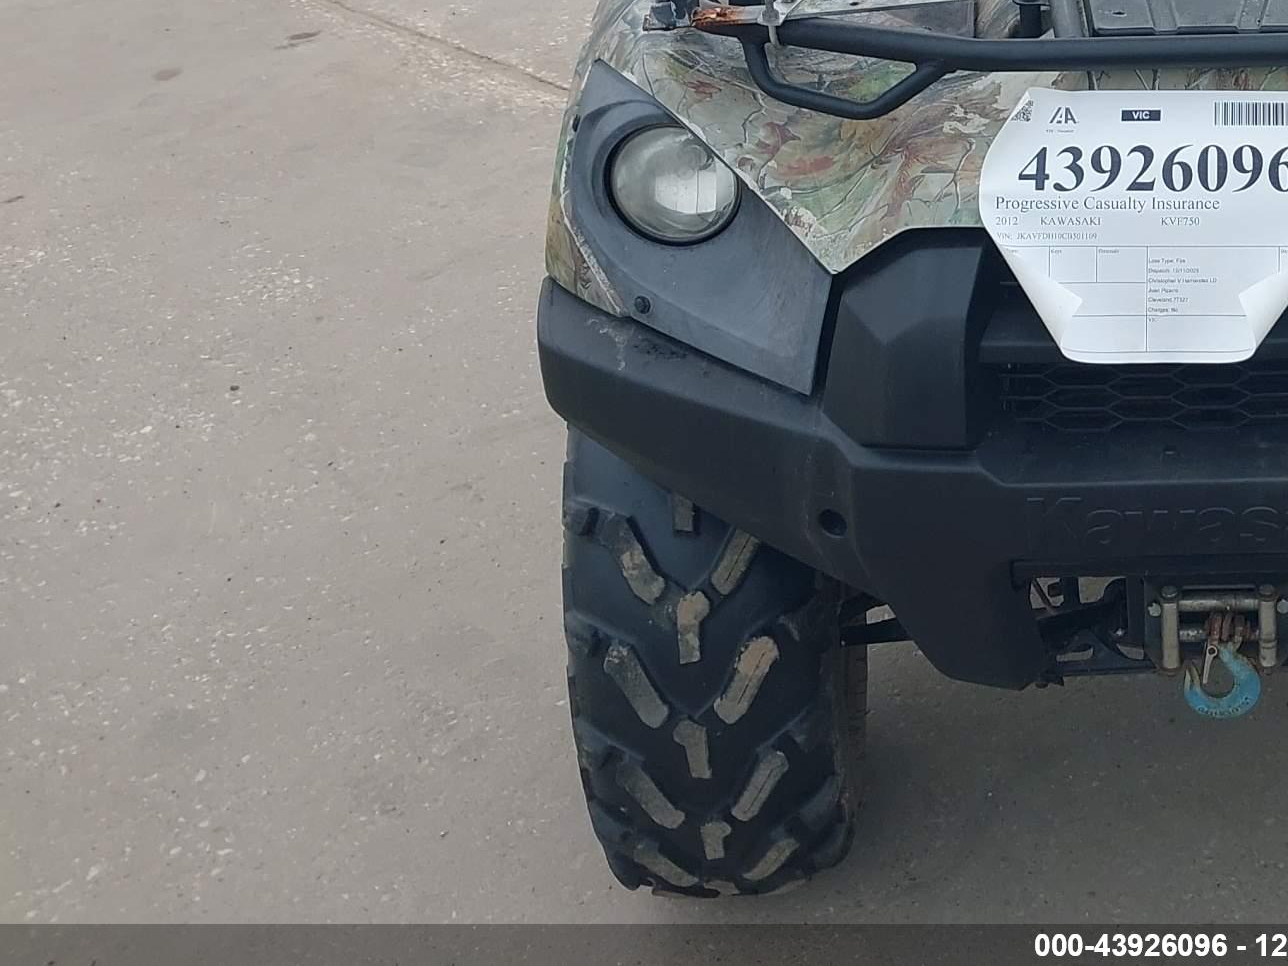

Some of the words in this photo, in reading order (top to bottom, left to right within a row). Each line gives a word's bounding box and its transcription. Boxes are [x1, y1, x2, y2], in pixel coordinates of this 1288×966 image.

[1132, 111, 1150, 120] VIC
[995, 196, 1079, 213] Progressive
[1083, 196, 1146, 213] Casualty
[1151, 196, 1220, 210] Insurance
[995, 216, 1018, 227] 2012
[1040, 216, 1101, 227] KAWASAKI
[1160, 216, 1200, 227] KVF750
